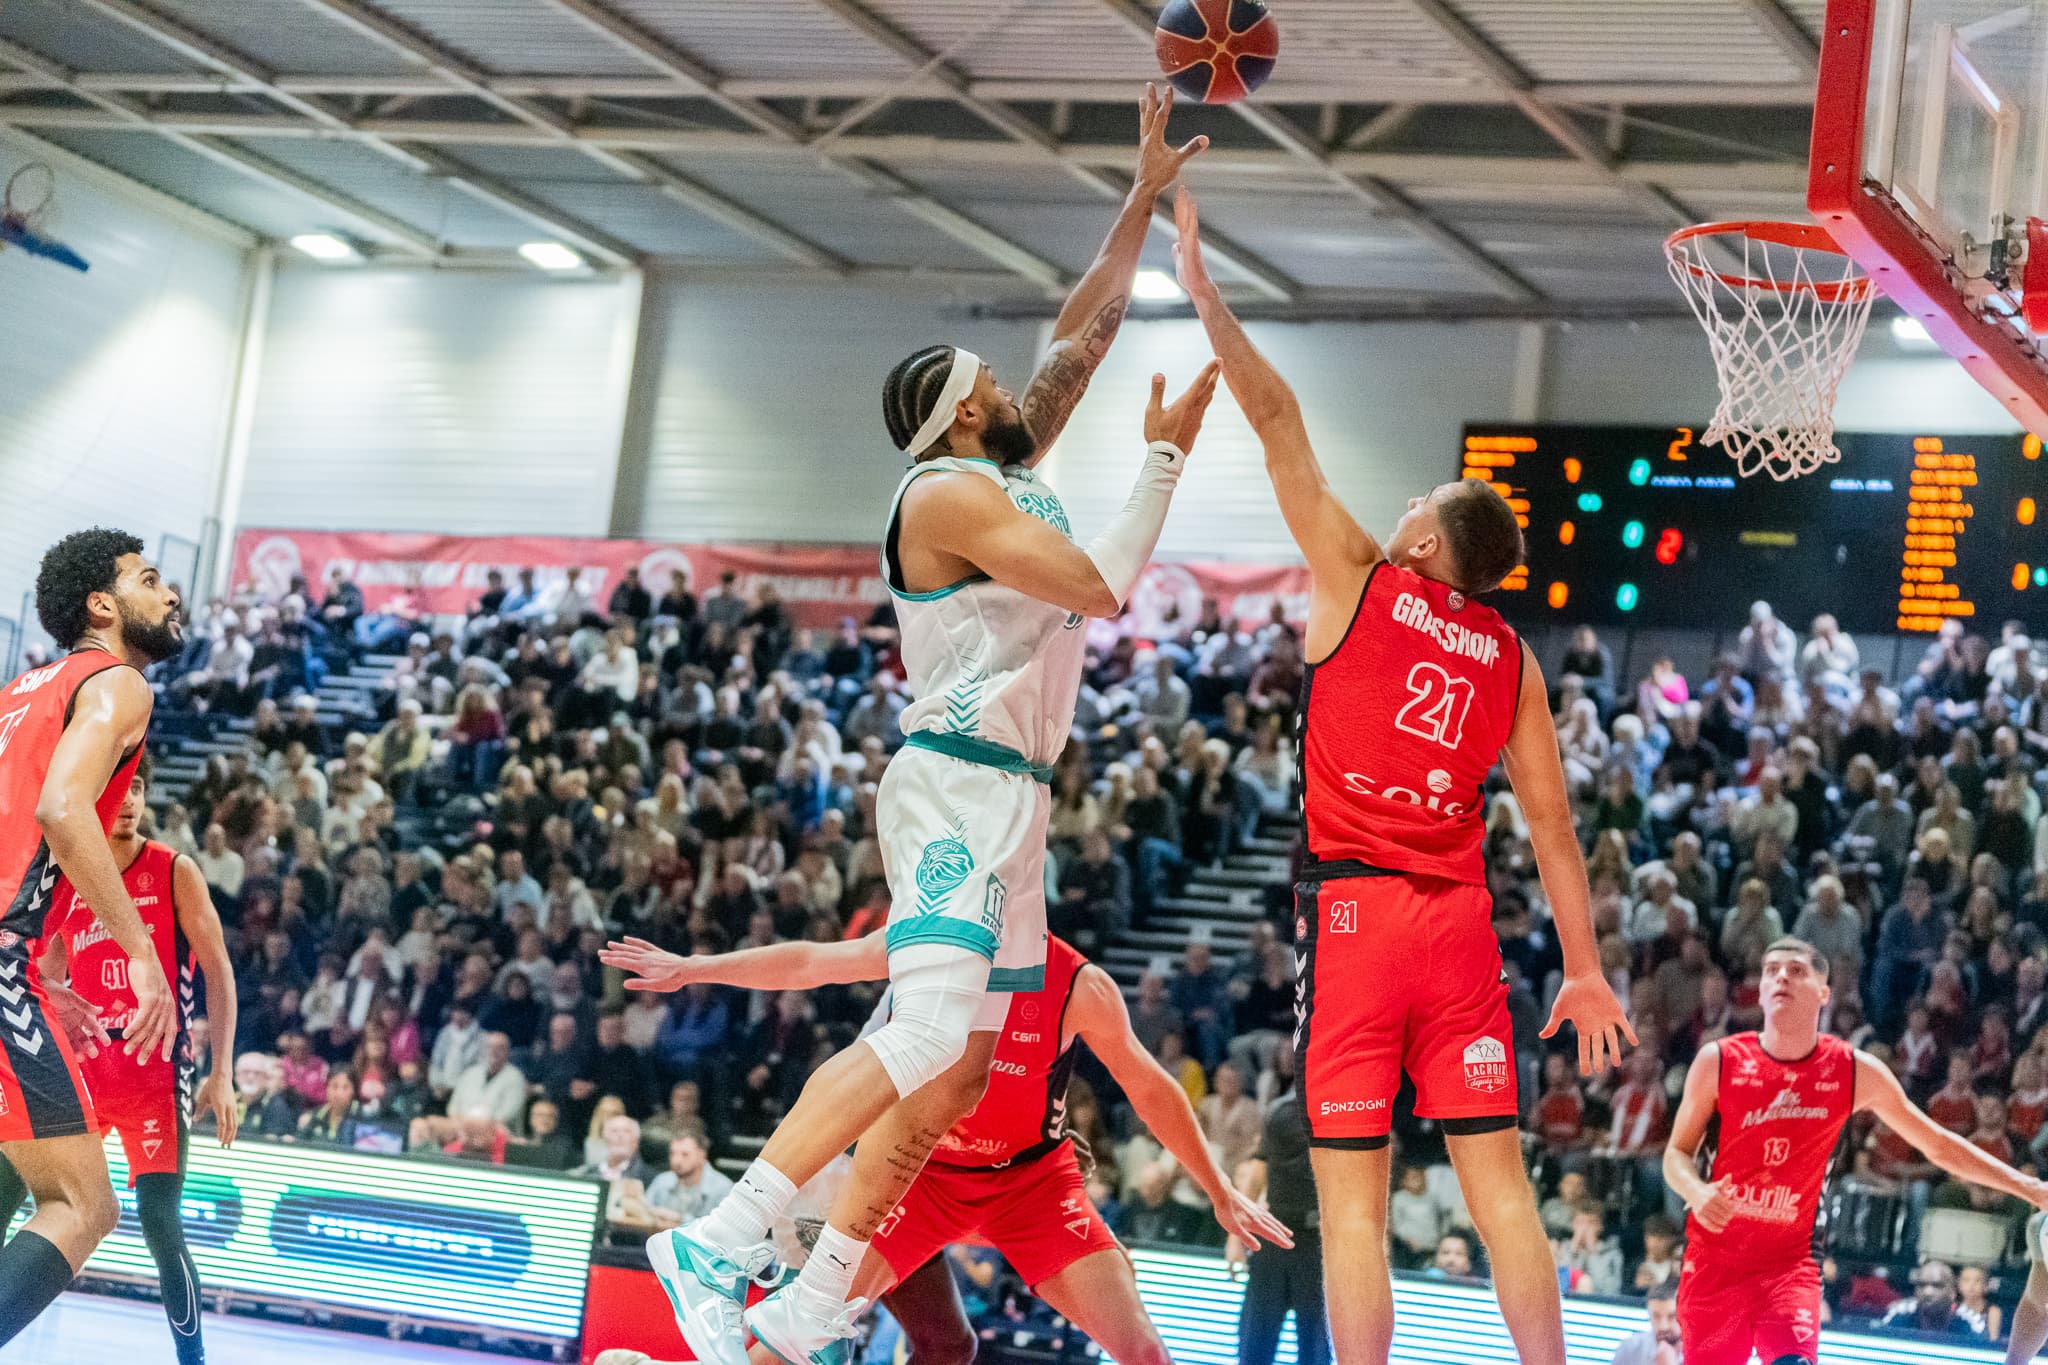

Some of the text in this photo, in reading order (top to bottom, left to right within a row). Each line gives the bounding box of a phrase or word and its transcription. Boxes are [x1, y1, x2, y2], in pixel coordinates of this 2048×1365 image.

[1667, 427, 1693, 461] 2
[1394, 661, 1475, 750] 21
[1330, 901, 1357, 933] 21
[101, 958, 128, 990] 41
[1465, 1063, 1506, 1079] LACROIX
[1320, 1097, 1387, 1116] SONZOGNI
[1763, 1137, 1790, 1167] 13
